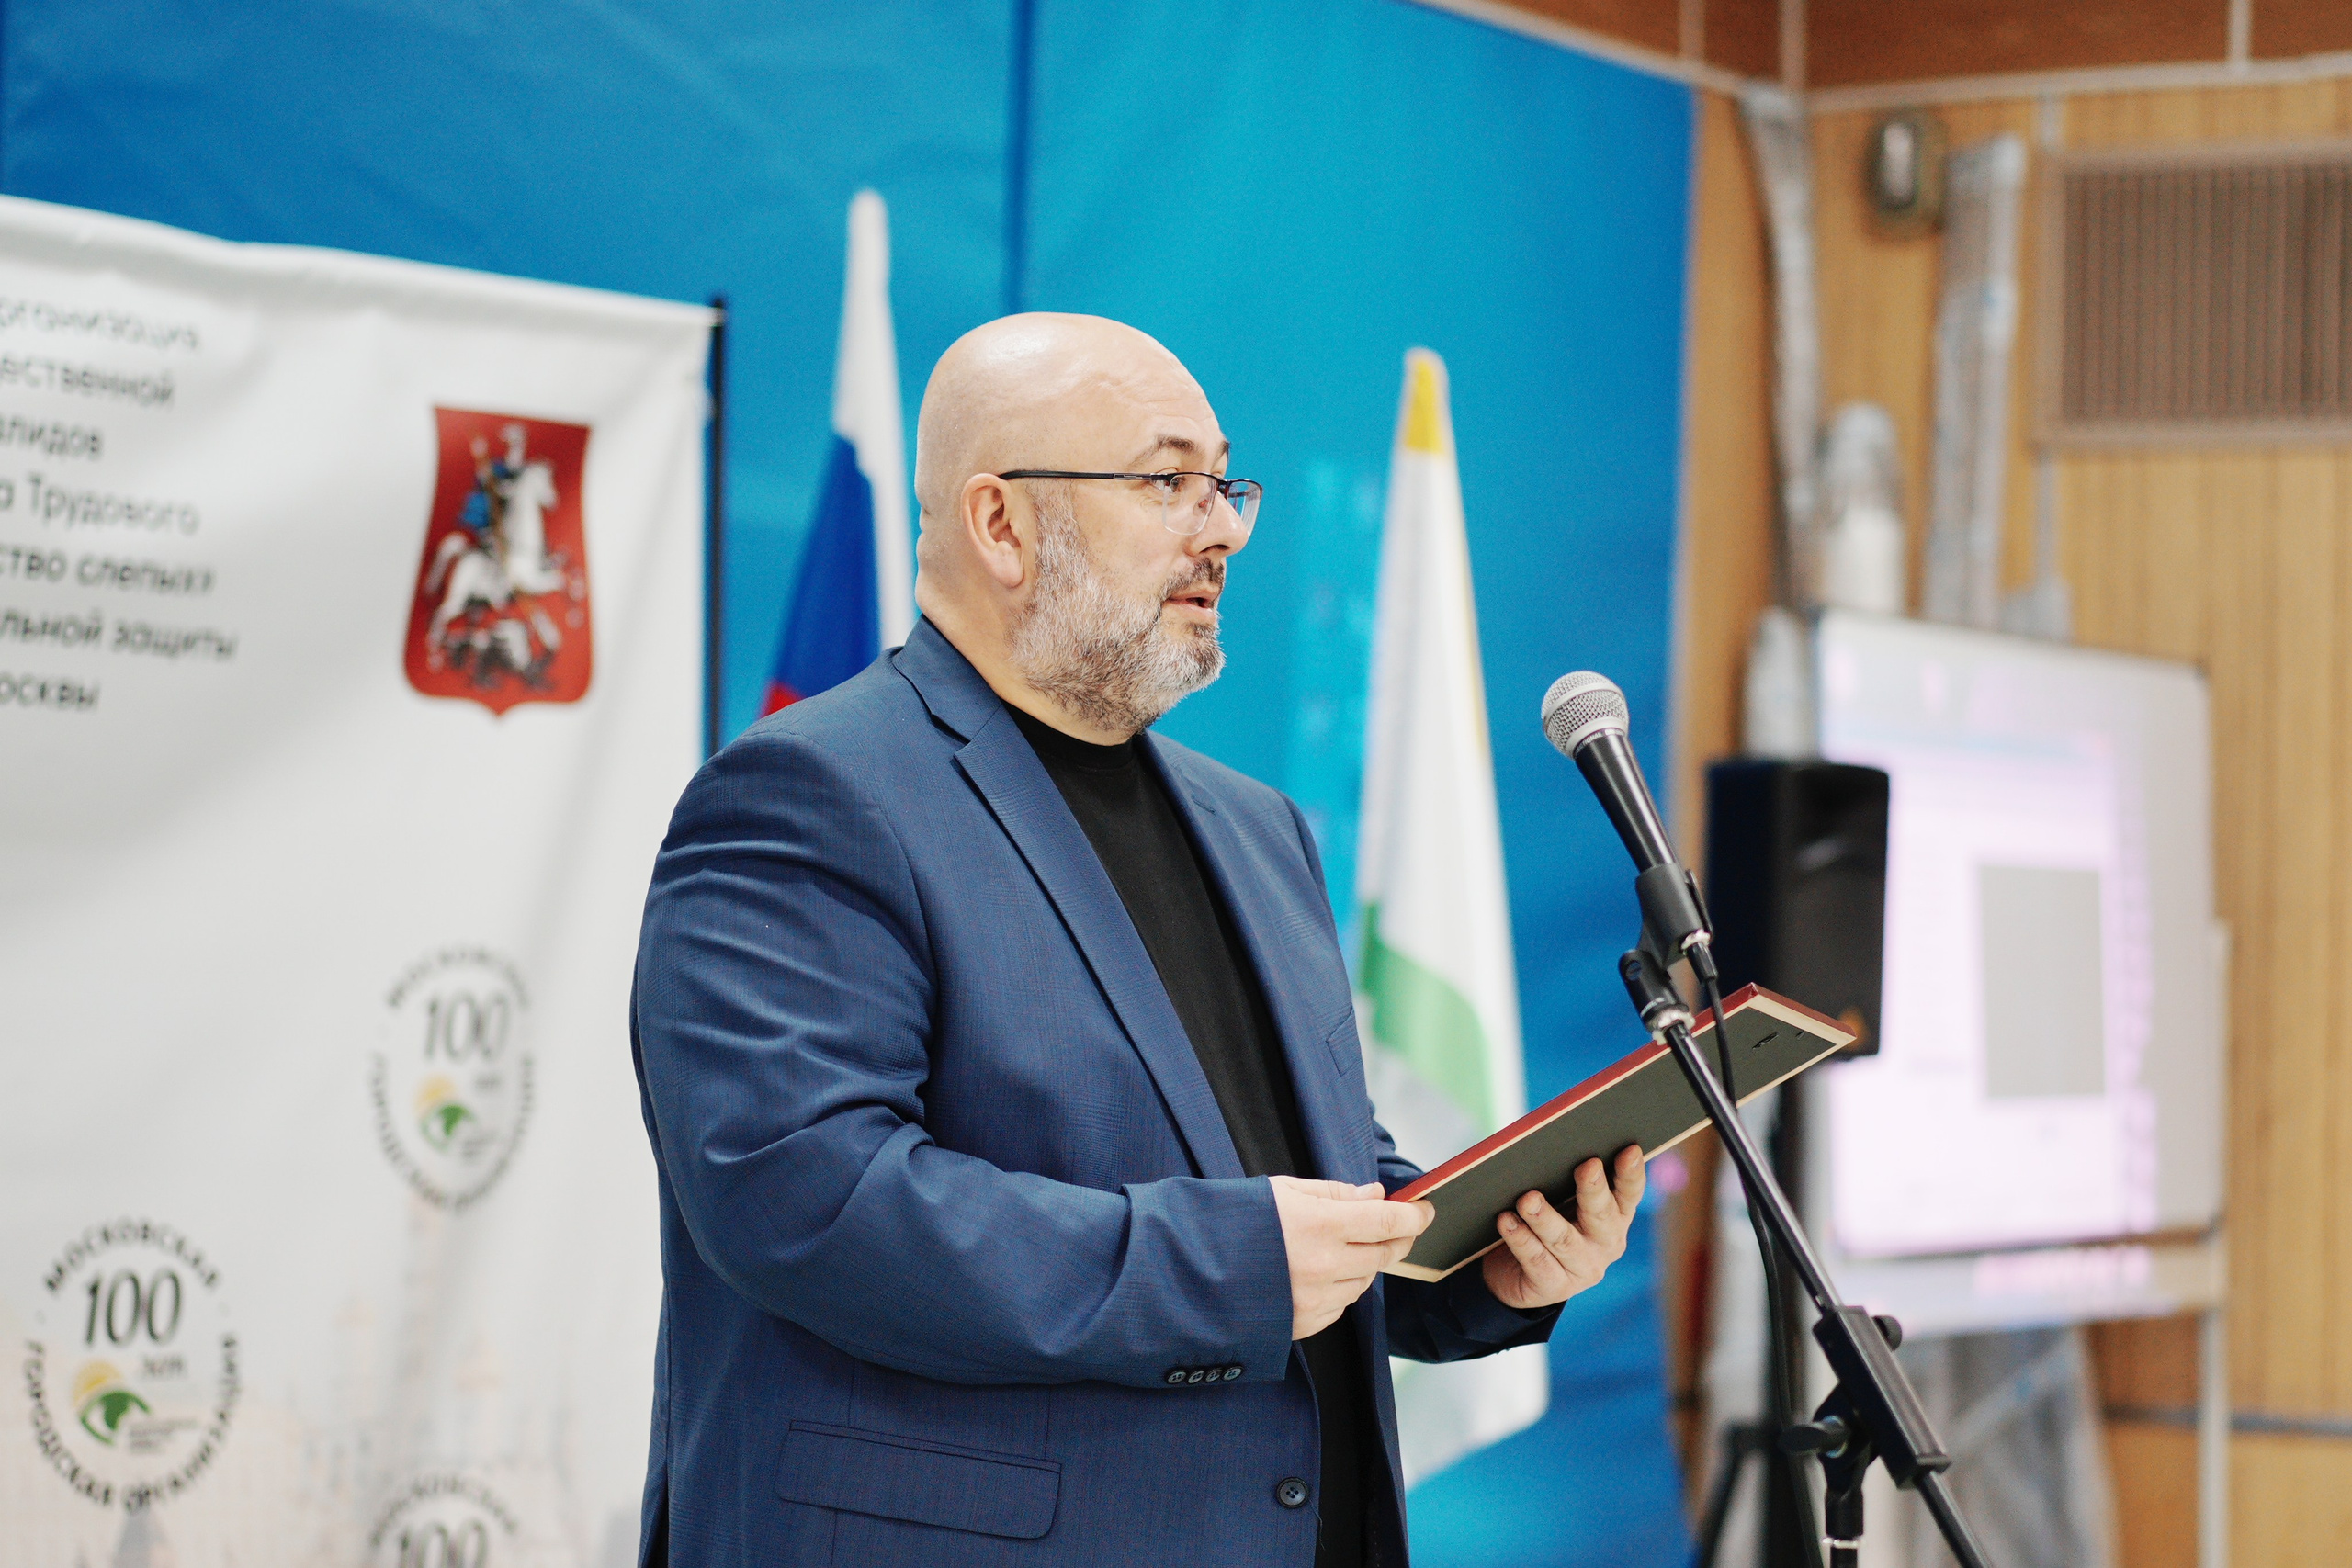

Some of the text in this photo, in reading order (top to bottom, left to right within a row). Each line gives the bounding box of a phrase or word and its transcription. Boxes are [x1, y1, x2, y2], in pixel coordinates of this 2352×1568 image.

[0, 414, 102, 457] лидов
[28, 472, 200, 536] Трудового
[424, 991, 511, 1062] 100
[85, 1265, 182, 1347] 100
